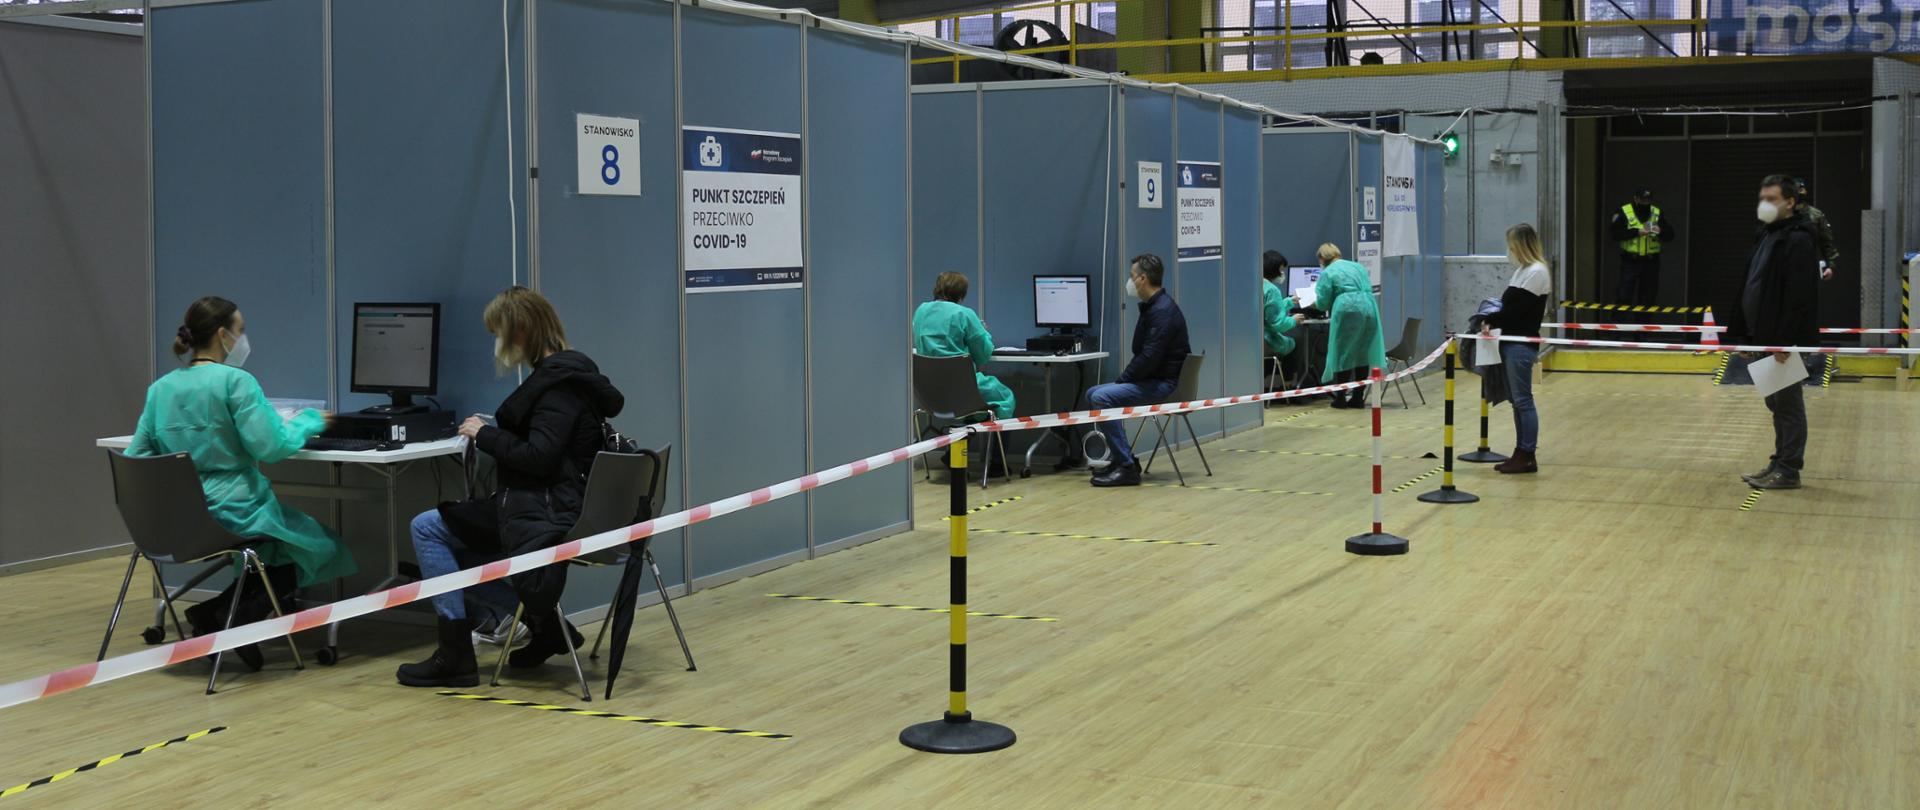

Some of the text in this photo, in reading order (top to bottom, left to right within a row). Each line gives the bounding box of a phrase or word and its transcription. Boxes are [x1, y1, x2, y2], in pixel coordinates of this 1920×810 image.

[584, 125, 634, 137] STANOWISKO
[602, 144, 620, 185] 8
[693, 187, 785, 205] PUNKT SZCZEPIEŃ
[1147, 178, 1155, 202] 9
[1367, 199, 1374, 216] 10
[693, 211, 754, 226] PRZECIWKO
[693, 233, 747, 249] COVID-19
